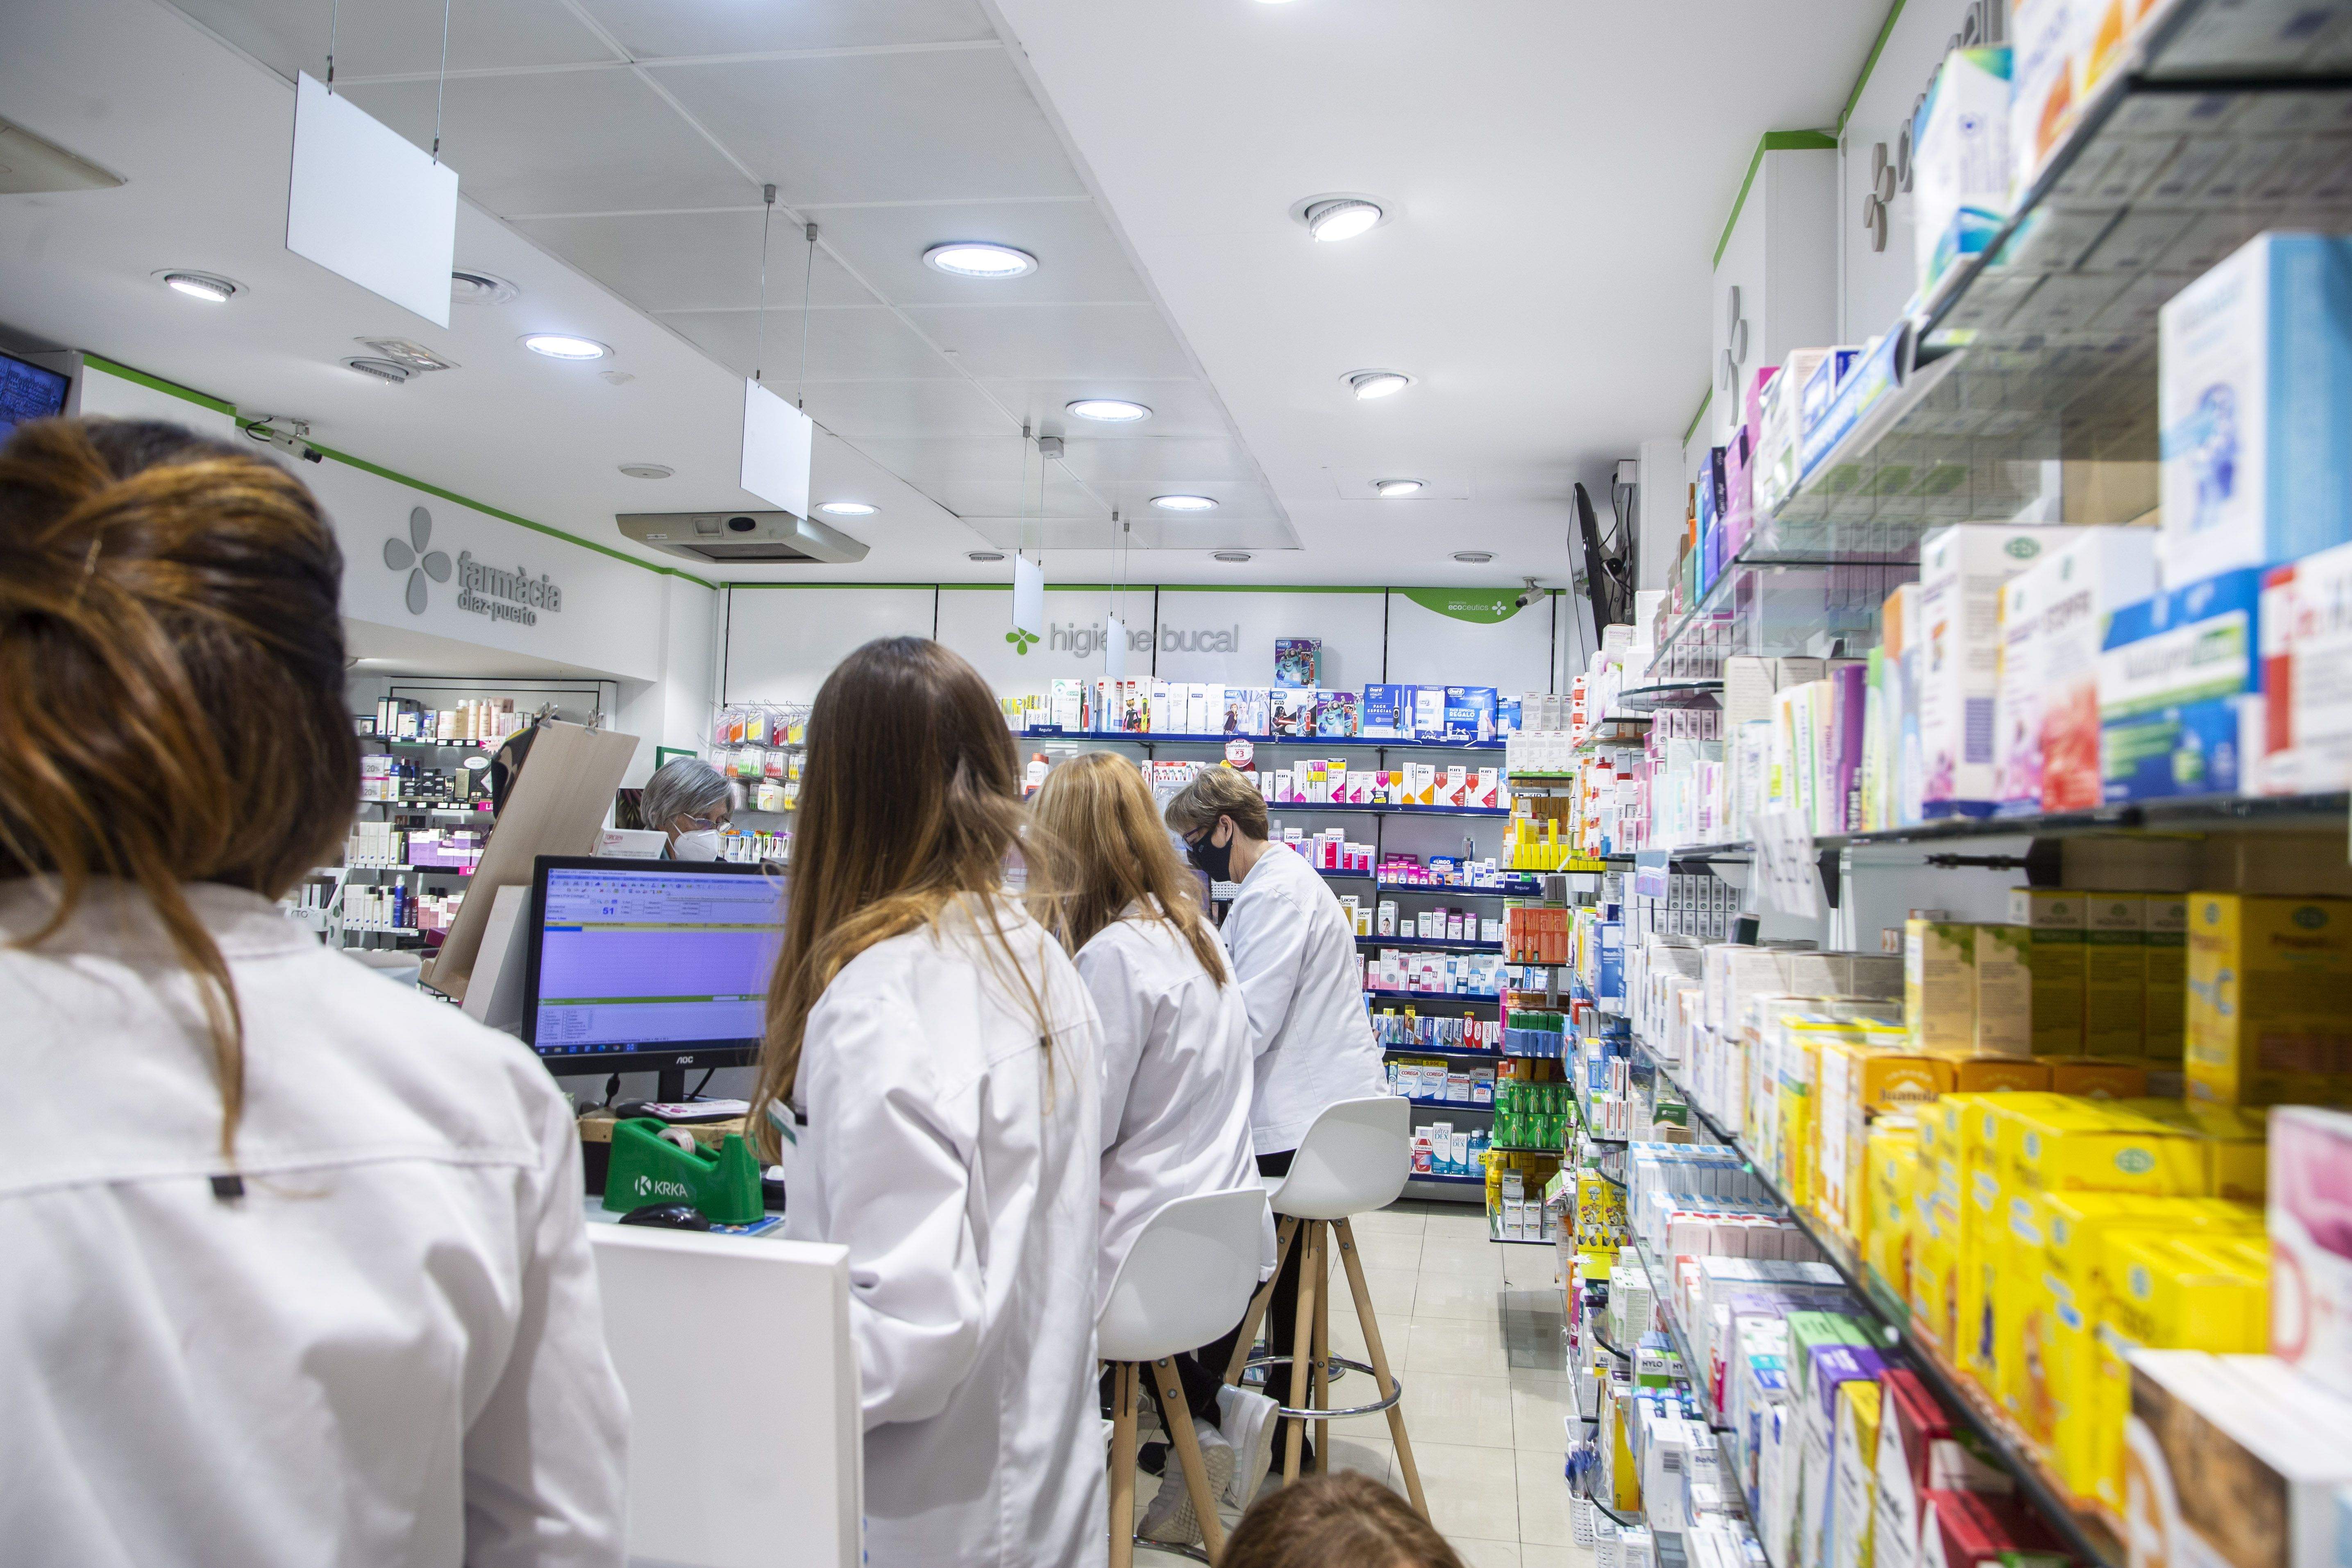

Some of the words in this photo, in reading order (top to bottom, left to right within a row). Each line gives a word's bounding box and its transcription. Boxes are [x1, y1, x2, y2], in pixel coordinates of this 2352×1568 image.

[458, 550, 562, 613] farmàcia
[1161, 623, 1239, 653] bucal
[602, 907, 615, 915] 51
[677, 1056, 693, 1064] AOC
[654, 1181, 688, 1198] KRKA
